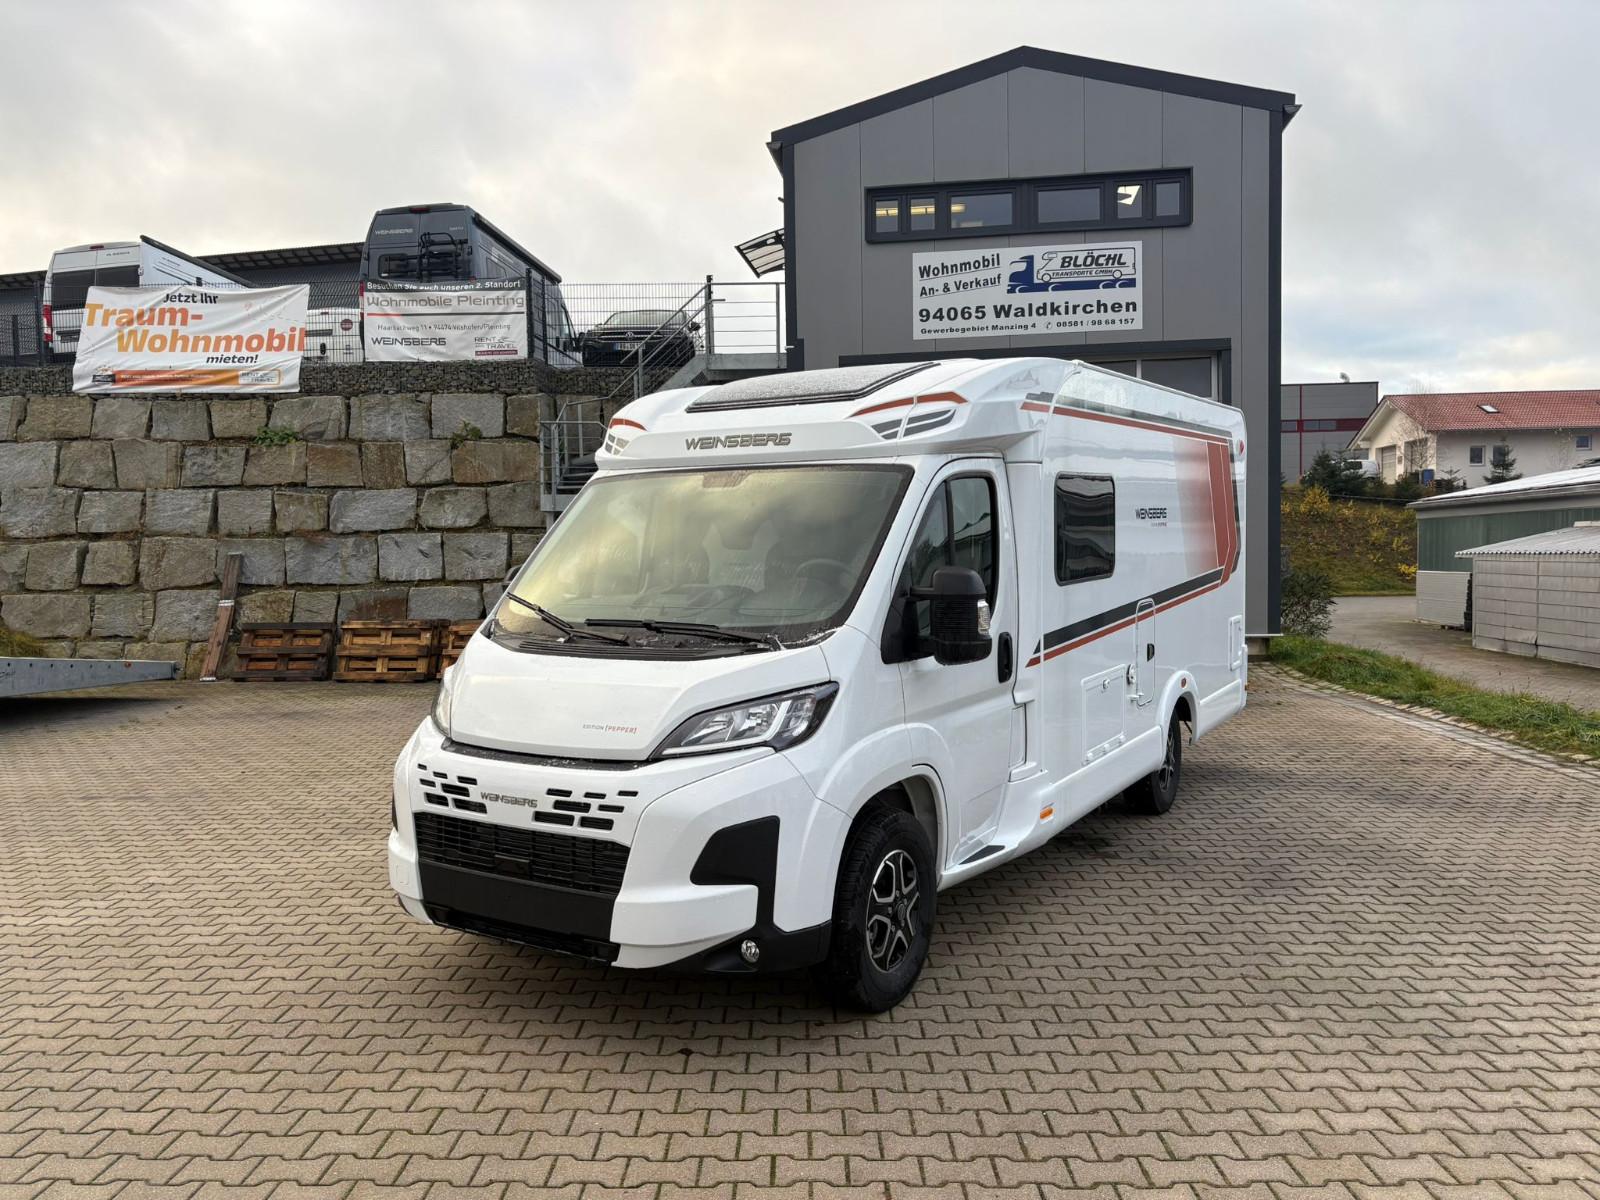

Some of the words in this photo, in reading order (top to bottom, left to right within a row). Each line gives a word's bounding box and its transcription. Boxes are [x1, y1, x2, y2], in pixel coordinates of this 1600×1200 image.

[918, 253, 1001, 279] Wohnmobil
[1060, 251, 1127, 269] BLÖCHL
[1051, 269, 1093, 278] TRANSPORTE
[440, 283, 474, 291] unseren
[484, 279, 521, 289] Standort
[919, 285, 939, 298] An-
[942, 282, 951, 294] &
[953, 273, 1002, 292] Verkauf
[163, 292, 198, 304] Jetzt
[200, 292, 218, 304] Ihr
[366, 295, 453, 308] Wohnmobile
[457, 294, 525, 308] Pleinting
[84, 303, 204, 327] Traum-
[918, 304, 987, 323] 94065
[992, 299, 1137, 319] Waldkirchen
[920, 325, 989, 335] Gewerbegebiet
[991, 323, 1029, 331] Manzing
[1118, 317, 1135, 325] 157
[115, 326, 307, 353] Wohnmobil
[371, 337, 447, 346] WEINSBERG
[206, 354, 258, 365] mieten!
[685, 432, 793, 451] WEINSBERG
[480, 791, 538, 808] WEINSBERG
